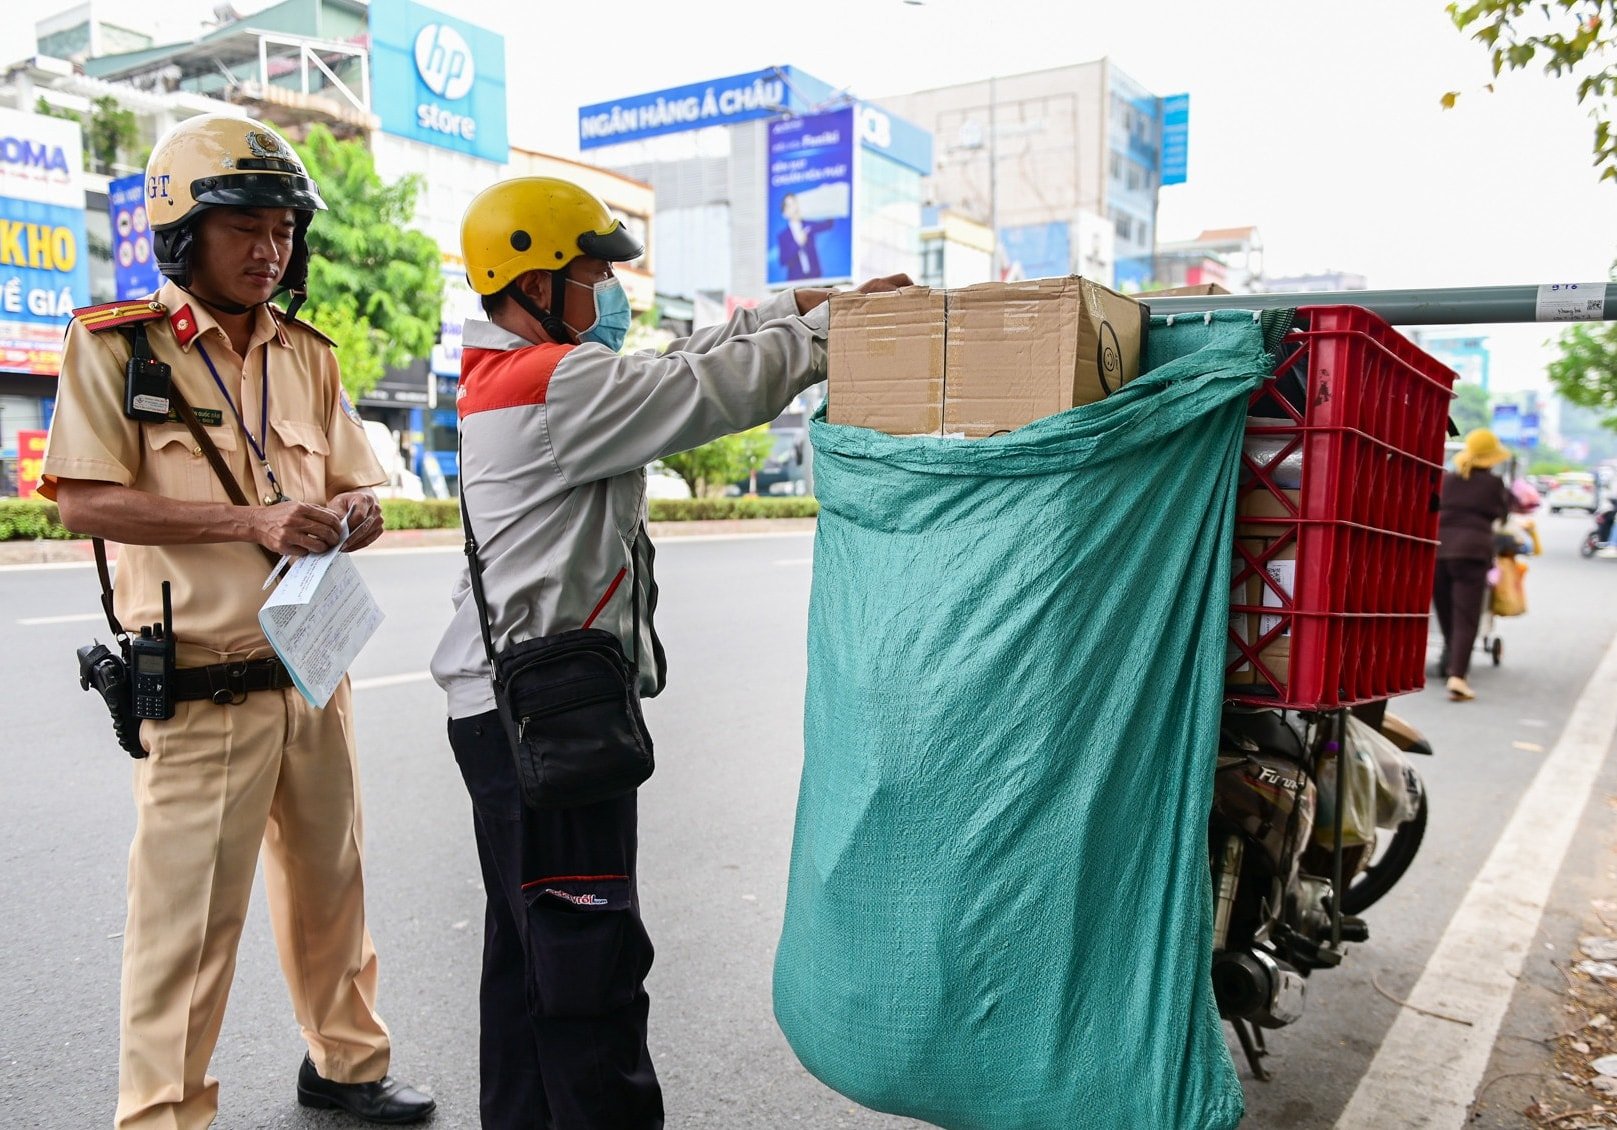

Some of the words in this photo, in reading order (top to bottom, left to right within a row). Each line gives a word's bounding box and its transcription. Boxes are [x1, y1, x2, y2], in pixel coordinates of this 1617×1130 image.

[417, 102, 476, 141] store
[581, 105, 639, 139] NGÂN
[640, 97, 700, 129] HÀNG
[720, 78, 784, 115] CHÂU
[0, 219, 76, 272] KHO
[27, 286, 75, 318] GIÁ
